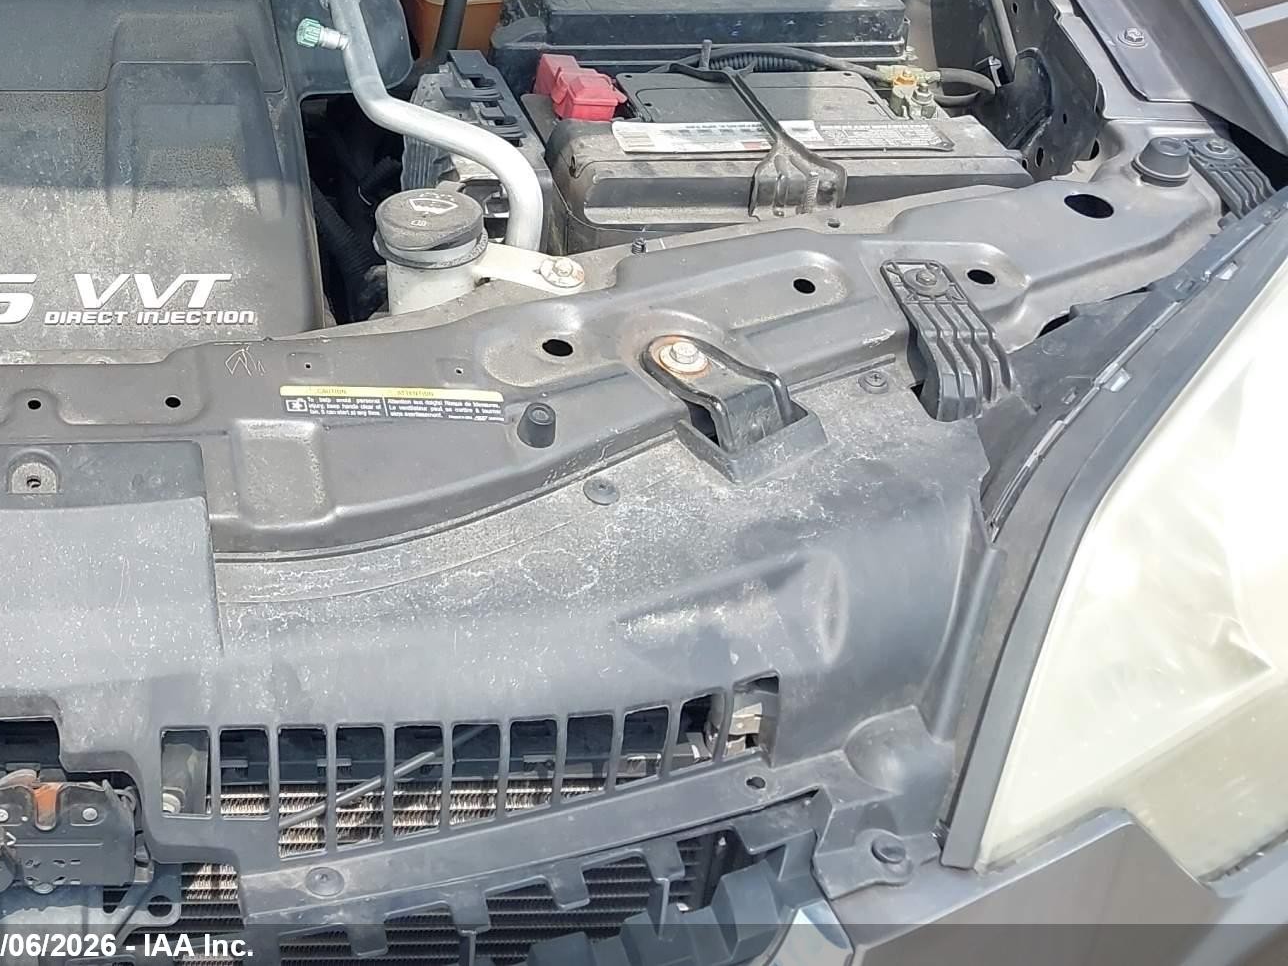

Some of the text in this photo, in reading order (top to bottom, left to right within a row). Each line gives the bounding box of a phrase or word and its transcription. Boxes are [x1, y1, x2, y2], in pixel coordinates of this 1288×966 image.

[73, 272, 233, 309] VVT
[43, 309, 255, 326] DIRECT INJECTION
